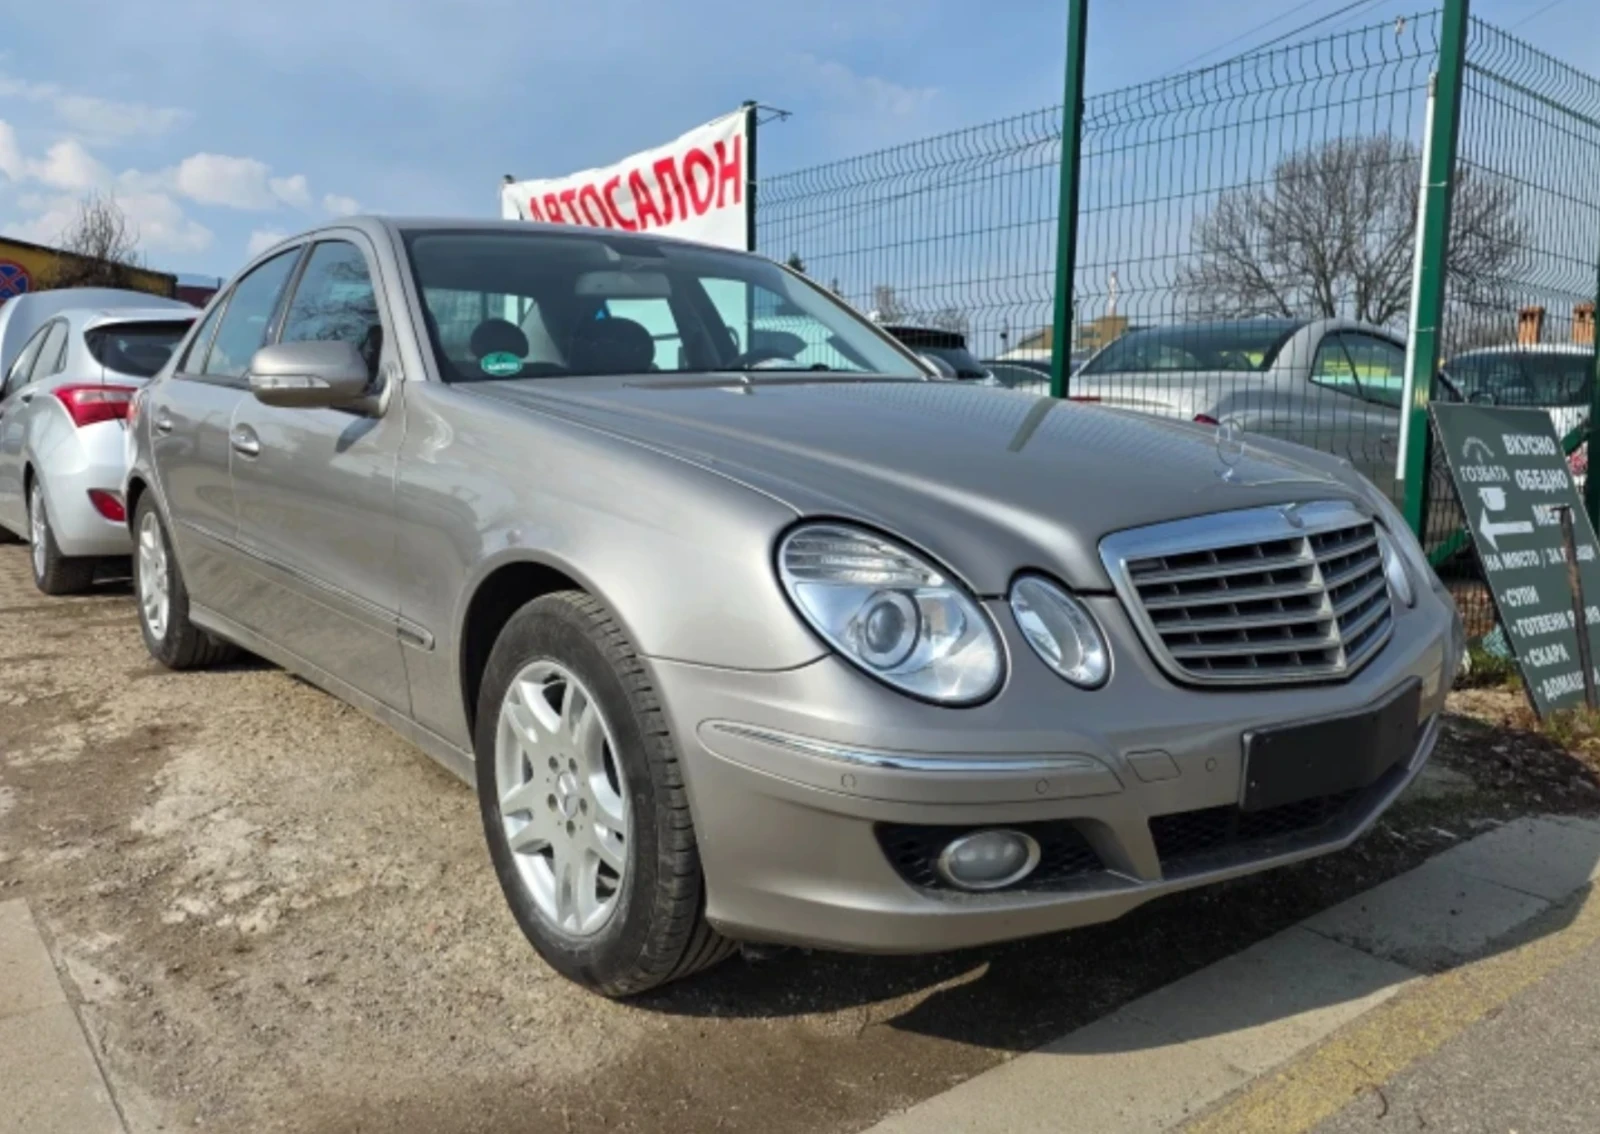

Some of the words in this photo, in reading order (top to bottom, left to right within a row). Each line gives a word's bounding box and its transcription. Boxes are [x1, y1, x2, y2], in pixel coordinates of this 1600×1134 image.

[529, 134, 742, 232] АВТОСАЛОН
[1501, 434, 1557, 456] ВКУСНО
[1515, 468, 1569, 494] ОБЕДНО
[1531, 504, 1575, 526] МЕ
[1484, 553, 1504, 572] НА
[1529, 643, 1571, 668] СКАРА
